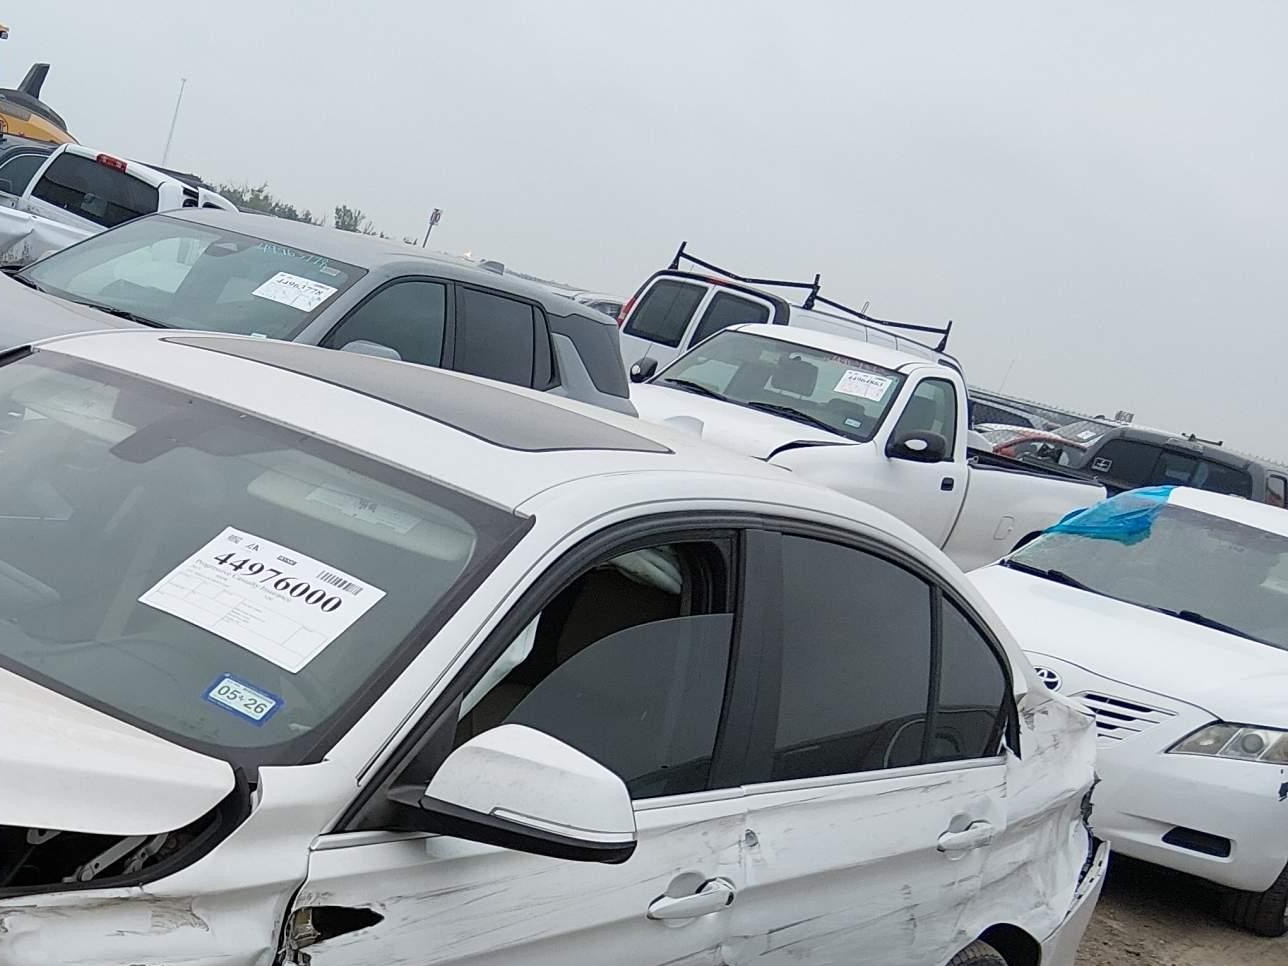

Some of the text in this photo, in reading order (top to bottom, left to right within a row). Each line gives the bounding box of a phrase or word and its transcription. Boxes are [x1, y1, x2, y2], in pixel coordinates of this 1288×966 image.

[214, 552, 343, 613] 44976000
[217, 684, 241, 701] 05
[243, 697, 268, 714] 26
